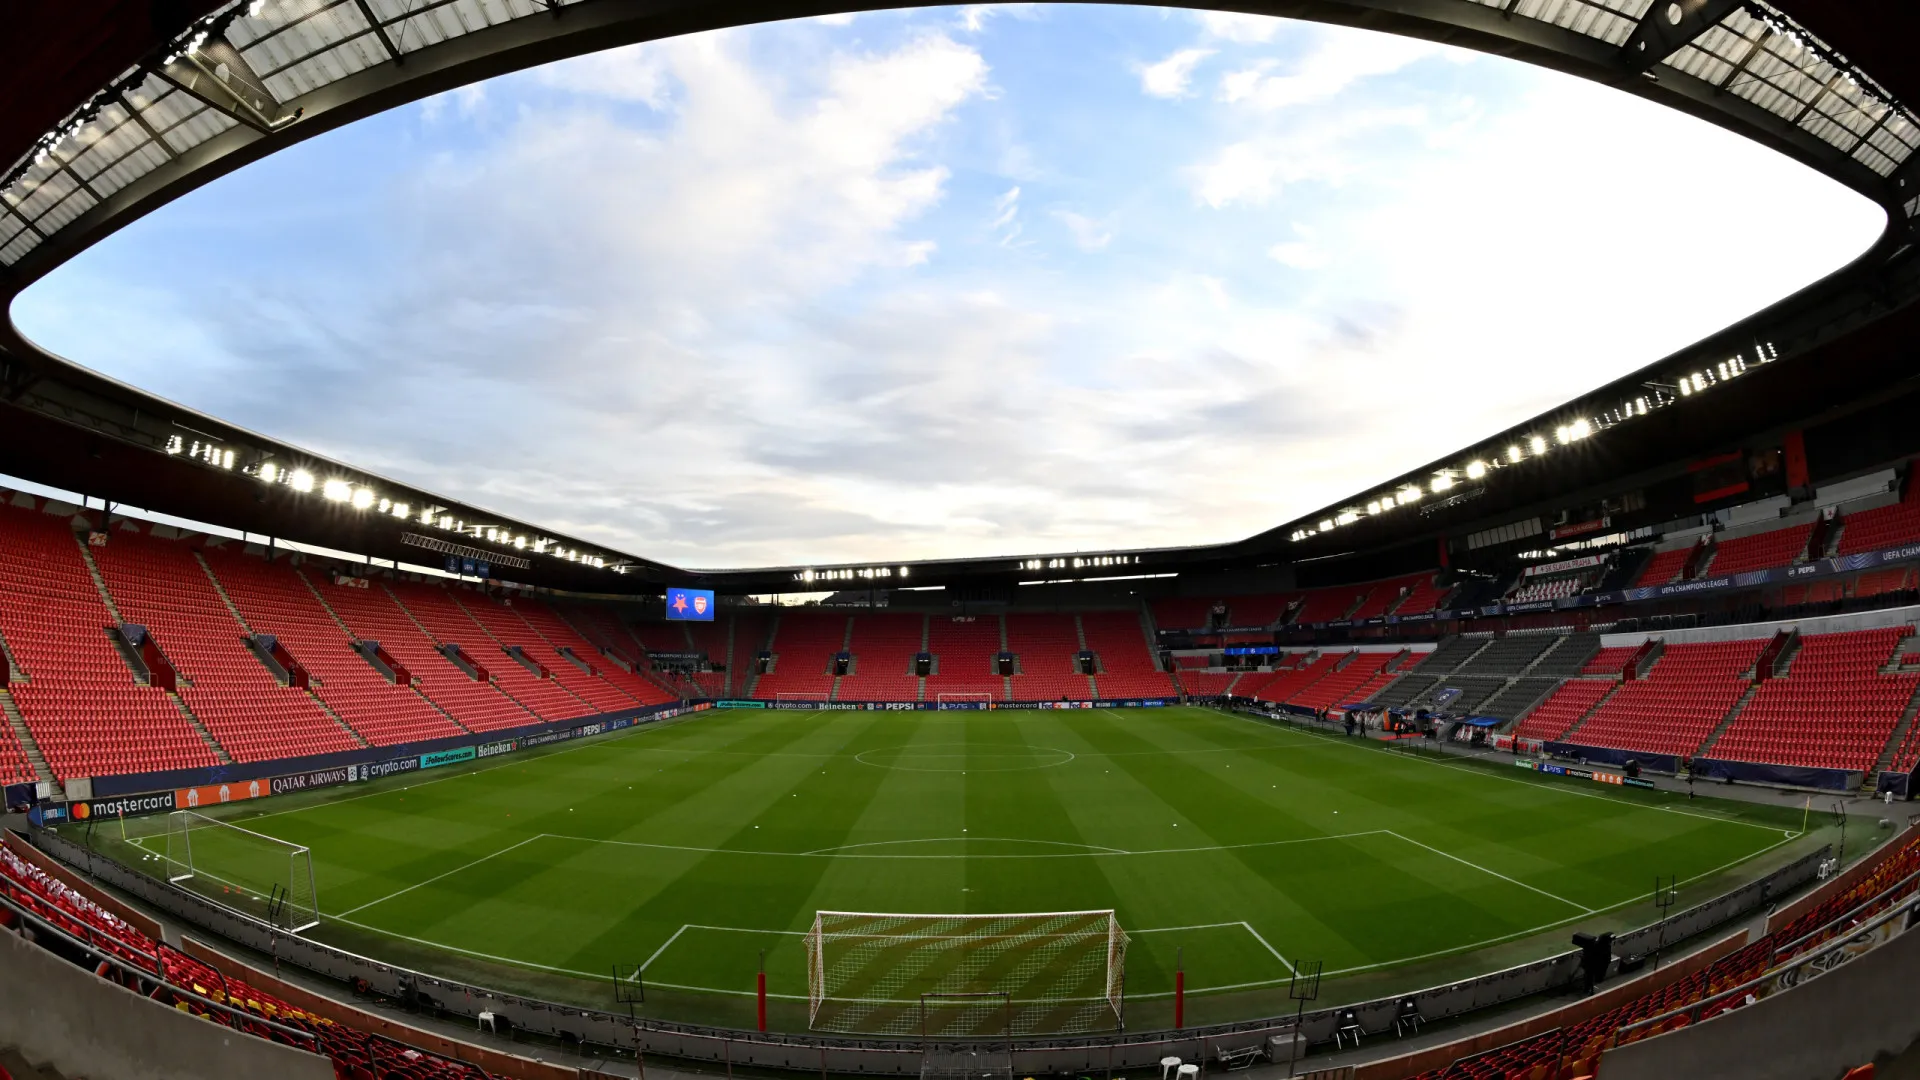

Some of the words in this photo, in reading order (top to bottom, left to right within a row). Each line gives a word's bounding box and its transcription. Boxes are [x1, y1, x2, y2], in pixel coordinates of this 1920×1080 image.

[1883, 549, 1901, 561] UEFA
[1553, 562, 1572, 571] SLAVIA
[1572, 559, 1592, 568] PRAHA
[1798, 566, 1816, 574] PEPSI
[1675, 582, 1707, 593] CHAMPIONS
[1707, 579, 1729, 588] LEAGUE
[775, 702, 812, 710] crypto.com
[819, 702, 856, 710] Heineken
[583, 723, 600, 737] PEPSI
[527, 738, 537, 746] UEFA
[537, 734, 558, 744] CHAMPIONS
[558, 732, 571, 742] LEAGUE
[478, 742, 511, 758] Heineken
[371, 758, 417, 776] crypto.com
[272, 774, 306, 792] QATAR
[309, 769, 346, 786] AIRWAYS
[93, 793, 173, 817] mastercard
